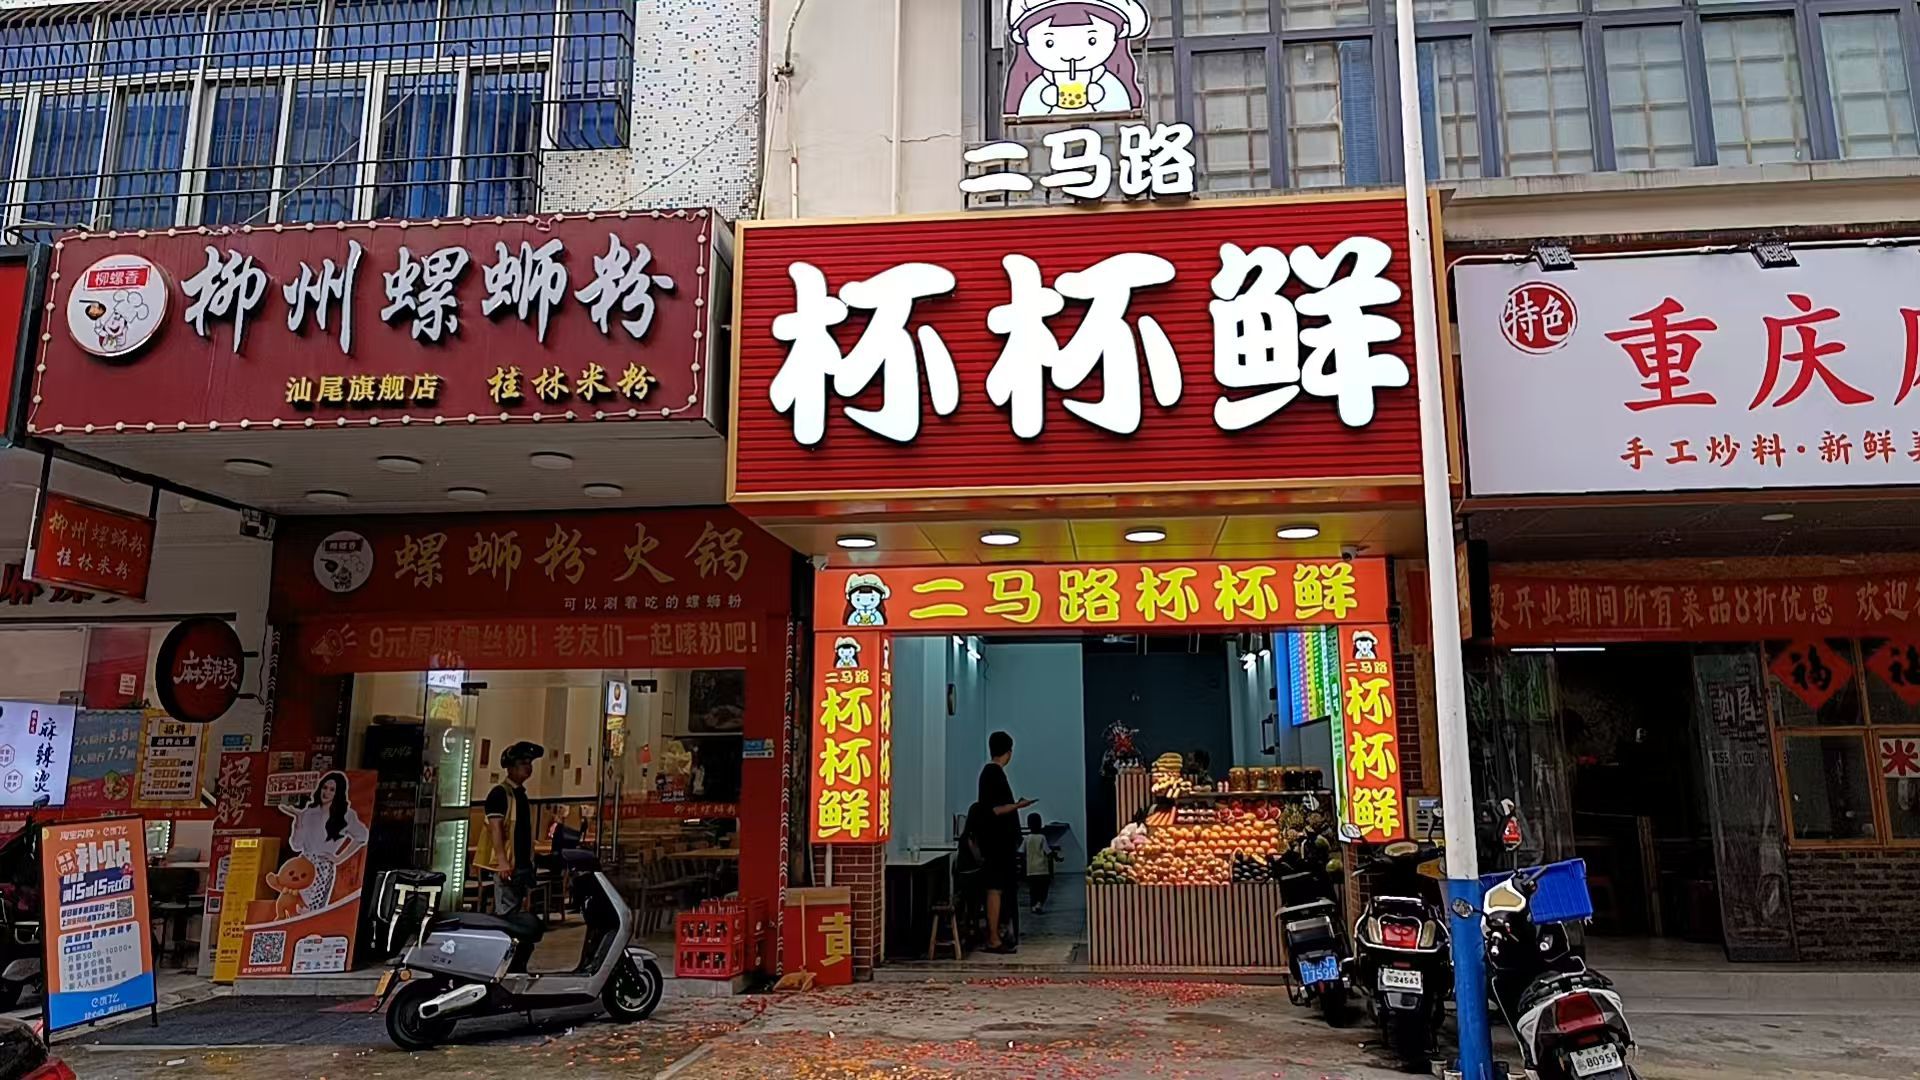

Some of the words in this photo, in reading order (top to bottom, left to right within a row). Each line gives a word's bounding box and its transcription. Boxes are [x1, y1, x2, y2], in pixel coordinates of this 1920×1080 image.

[960, 122, 1196, 200] 二马路
[94, 271, 141, 287] 柳螺香
[181, 233, 674, 354] 柳州螺蛳粉
[769, 235, 1411, 445] 杯杯鲜
[1503, 289, 1573, 344] 特色
[1604, 294, 1920, 412] 重庆
[285, 374, 440, 404] 汕尾旗舰店
[487, 361, 657, 405] 桂林米粉
[48, 510, 147, 557] 柳州螺蛳粉
[394, 521, 749, 592] 螺蛳粉火锅
[56, 546, 131, 580] 桂林米粉
[564, 593, 742, 612] 可以涮着吃的螺蛳粉
[908, 562, 1357, 622] 二马路杯杯鲜
[172, 648, 239, 690] 麻辣烫
[824, 669, 870, 684] 二马路
[1345, 661, 1388, 675] 二马路
[1791, 644, 1832, 692] 福
[32, 717, 59, 793] 麻辣烫
[817, 686, 873, 838] 杯杯鲜
[1345, 677, 1399, 837] 杯杯鲜
[1303, 967, 1337, 982] 77590
[1586, 1051, 1618, 1068] 80959
